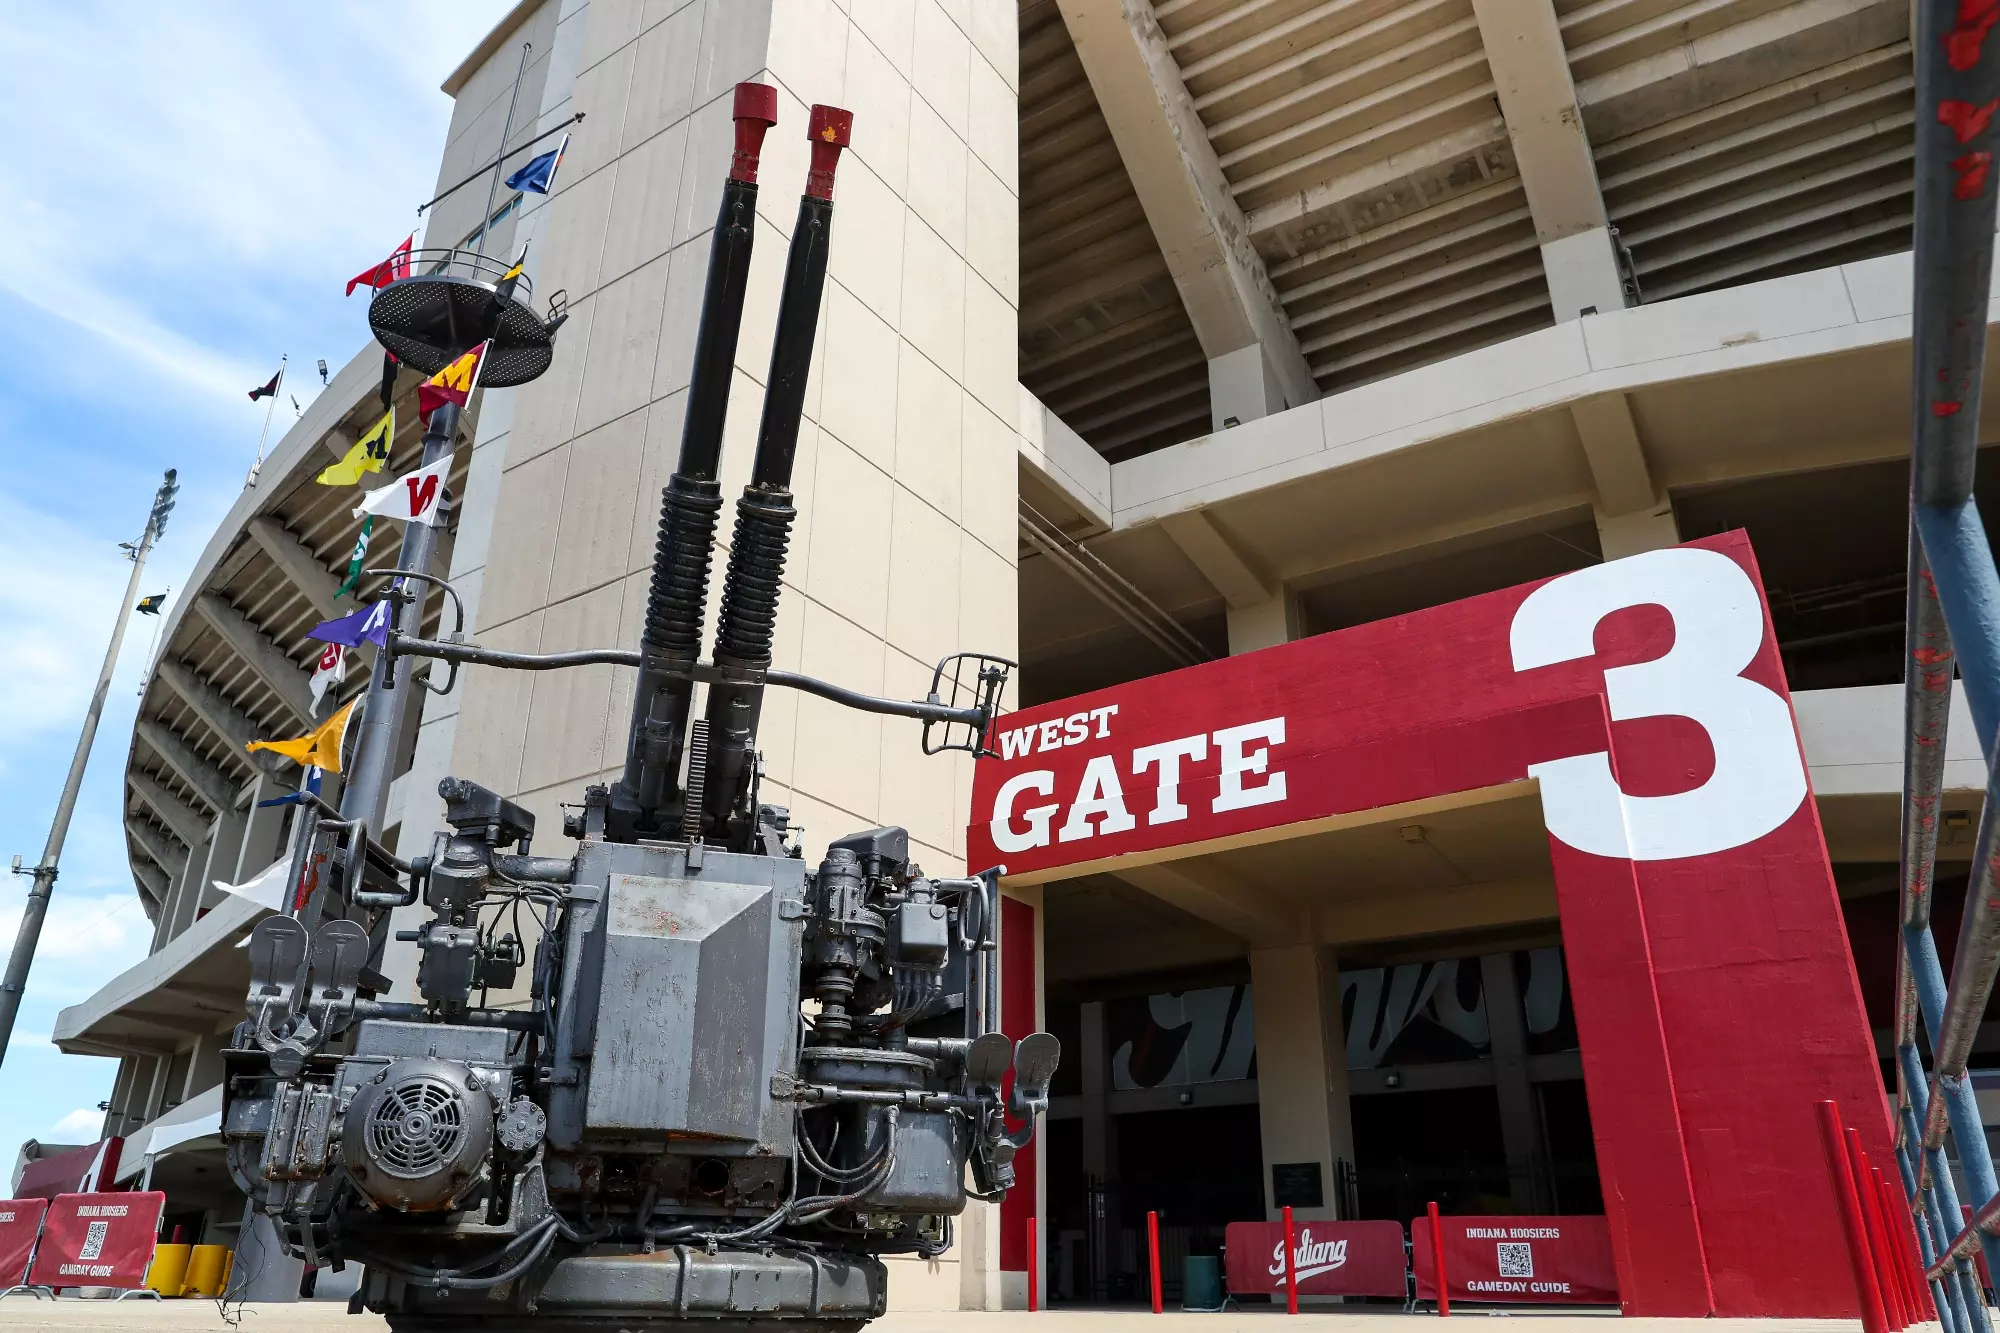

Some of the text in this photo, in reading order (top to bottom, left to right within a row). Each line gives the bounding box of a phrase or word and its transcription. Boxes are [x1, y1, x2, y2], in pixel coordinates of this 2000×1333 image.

[1510, 547, 1808, 861] 3
[999, 704, 1119, 761] WEST
[990, 716, 1287, 853] GATE
[77, 1205, 129, 1217] INDIANA HOOSIERS
[1466, 1228, 1560, 1239] INDIANA HOOSIERS
[59, 1263, 114, 1277] GAMEDAY GUIDE
[1467, 1281, 1571, 1293] GAMEDAY GUIDE
